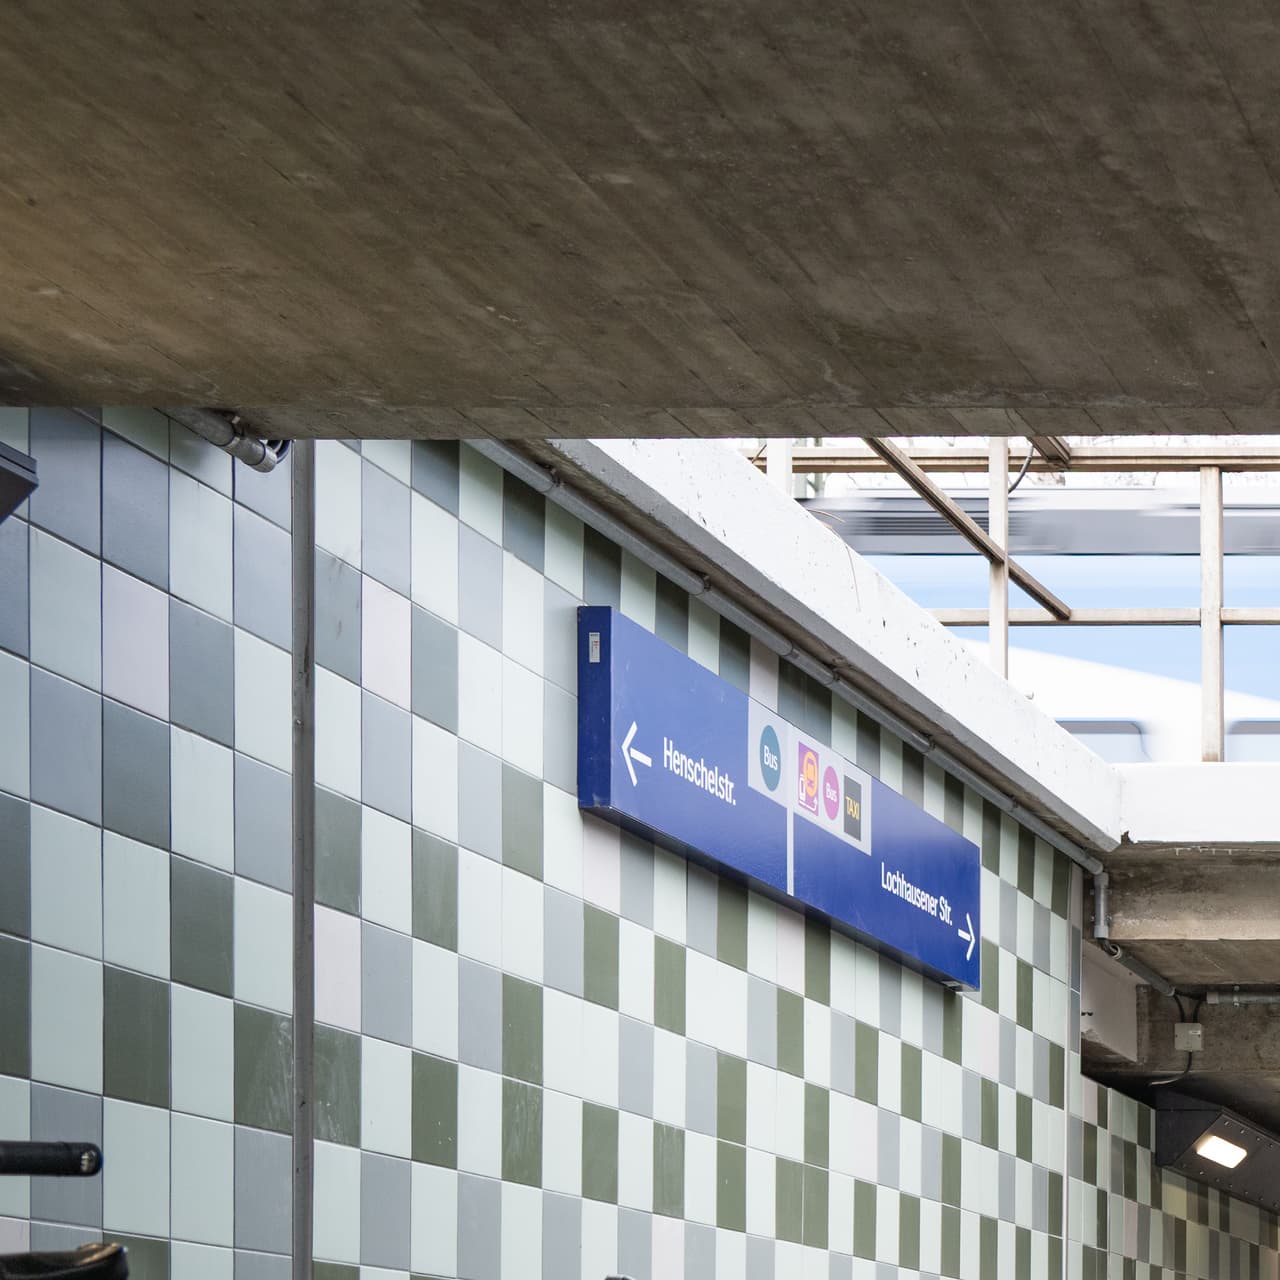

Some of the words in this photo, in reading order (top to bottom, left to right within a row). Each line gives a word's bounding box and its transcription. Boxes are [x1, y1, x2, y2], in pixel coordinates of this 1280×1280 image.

[663, 736, 736, 806] Henschelstr.
[763, 745, 778, 771] Bus
[825, 782, 837, 803] Bus
[845, 796, 860, 820] TAXI
[881, 861, 938, 917] Lochhausener
[939, 895, 953, 926] Str.
